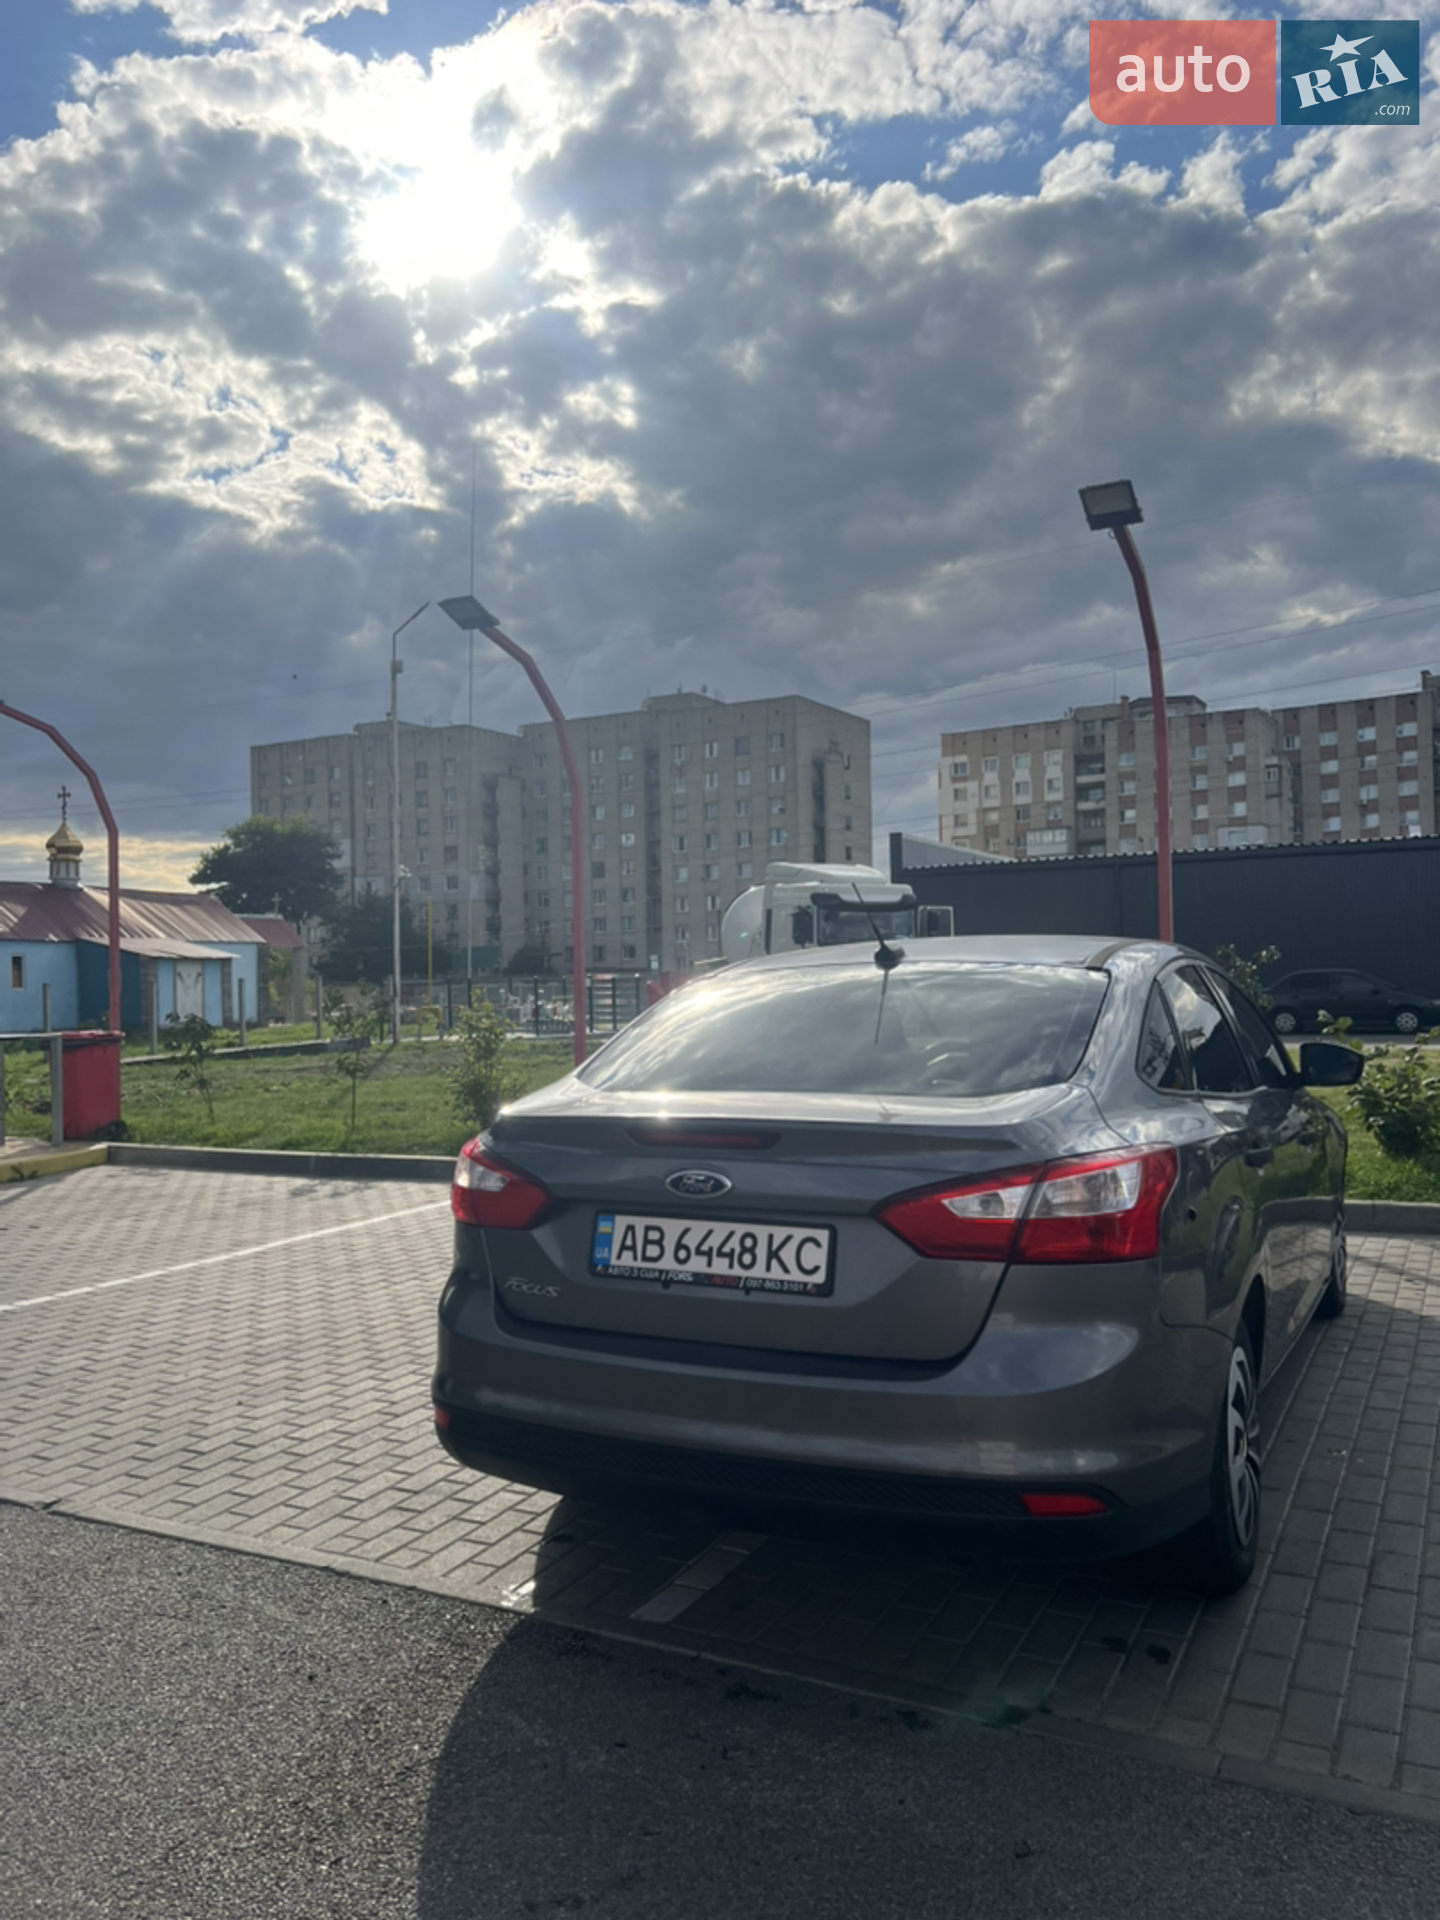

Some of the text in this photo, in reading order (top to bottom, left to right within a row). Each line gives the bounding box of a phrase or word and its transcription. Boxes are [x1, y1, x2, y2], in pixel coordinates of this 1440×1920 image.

[680, 1174, 714, 1192] Ford
[615, 1224, 823, 1276] AB 6448 KC
